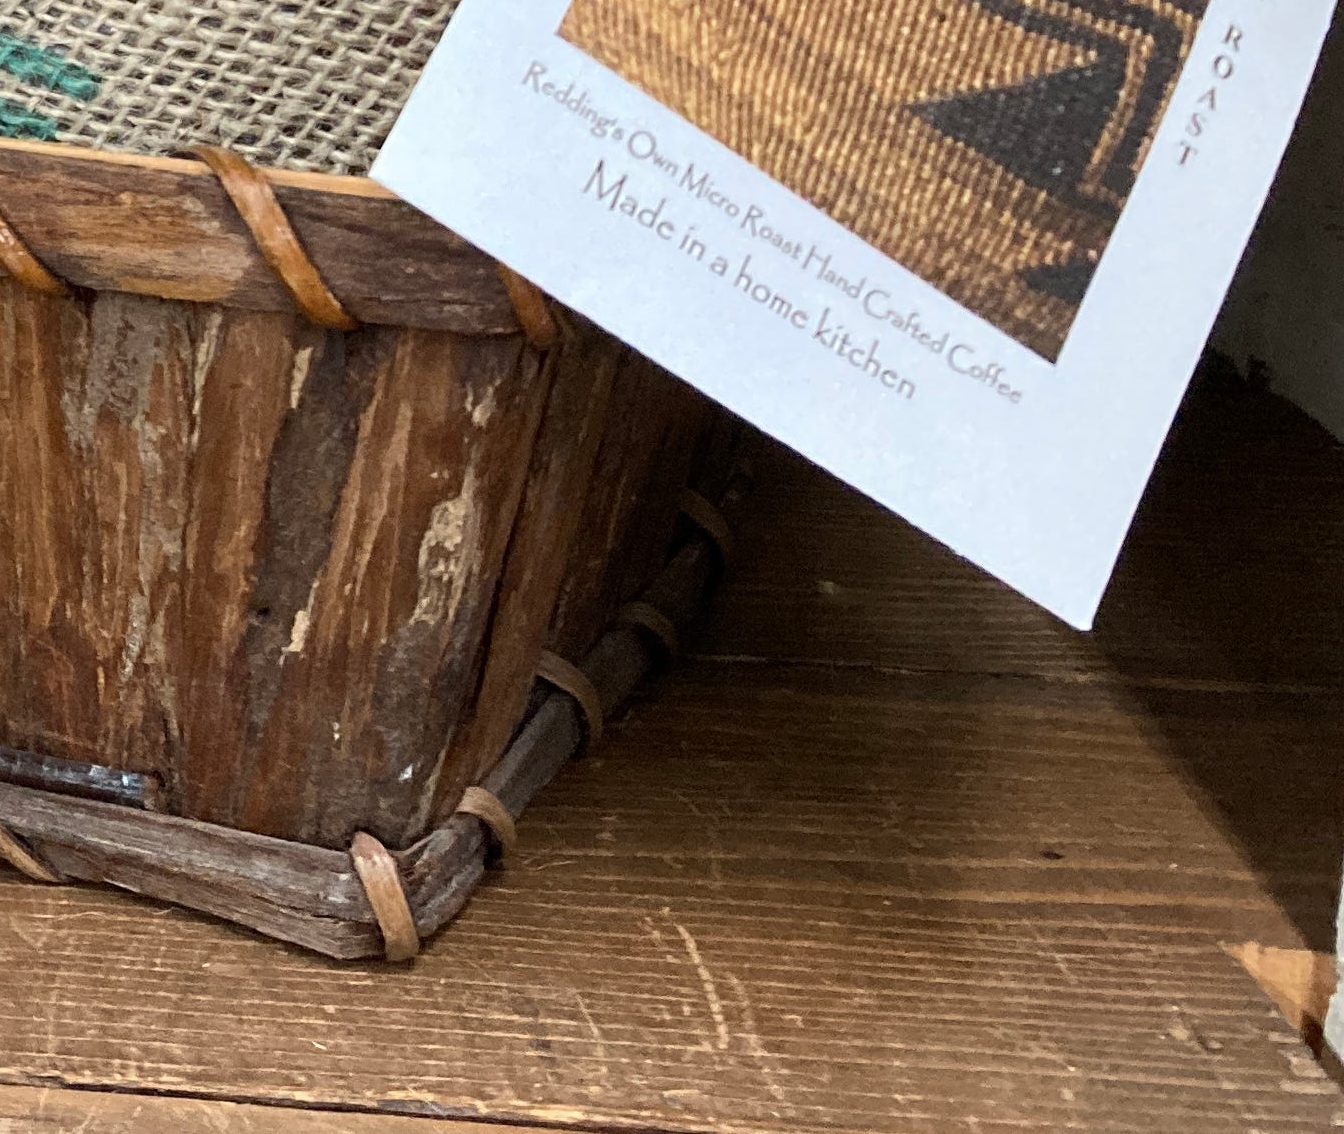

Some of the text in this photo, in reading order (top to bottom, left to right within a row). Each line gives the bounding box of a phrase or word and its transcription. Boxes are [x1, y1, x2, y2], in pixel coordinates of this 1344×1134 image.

[1177, 24, 1243, 167] ROAST
[520, 60, 1022, 405] Redding's Own Micro Roast Hand Crafted Coffee
[582, 159, 917, 400] Made in a home kitchen
